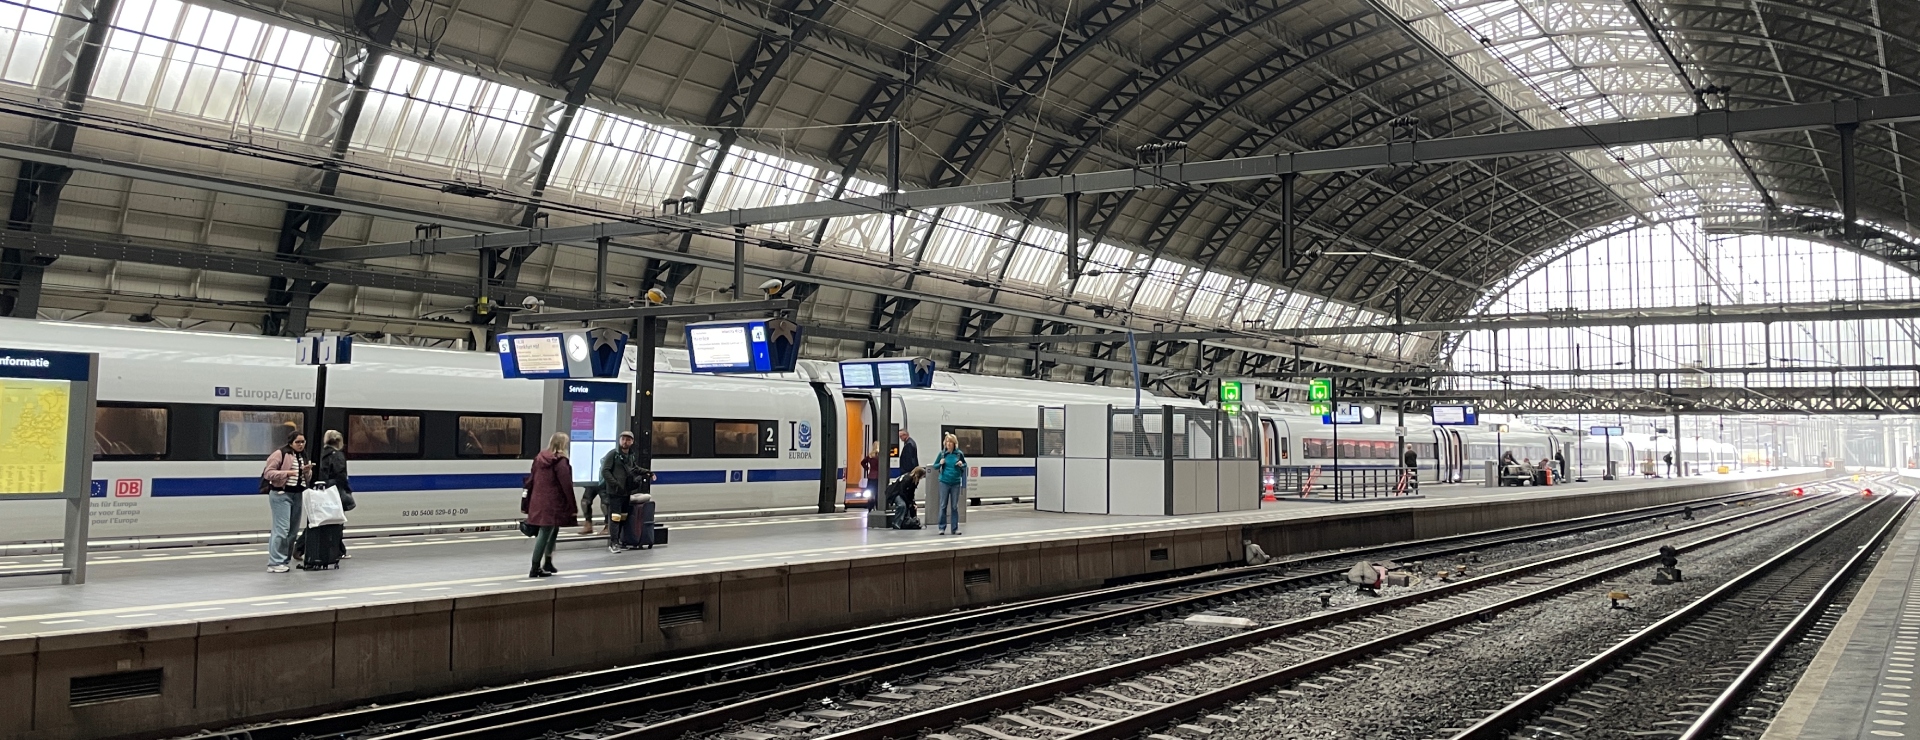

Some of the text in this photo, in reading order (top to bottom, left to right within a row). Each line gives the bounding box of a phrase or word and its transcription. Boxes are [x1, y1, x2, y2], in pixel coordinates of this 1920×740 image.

[301, 347, 306, 362] J
[325, 346, 330, 362] J
[569, 385, 589, 394] Service
[766, 427, 774, 442] 2
[788, 421, 797, 451] I
[788, 452, 812, 460] EUROPA
[118, 481, 139, 495] DB
[116, 509, 141, 517] Europa
[92, 517, 139, 526] pour l'Europe
